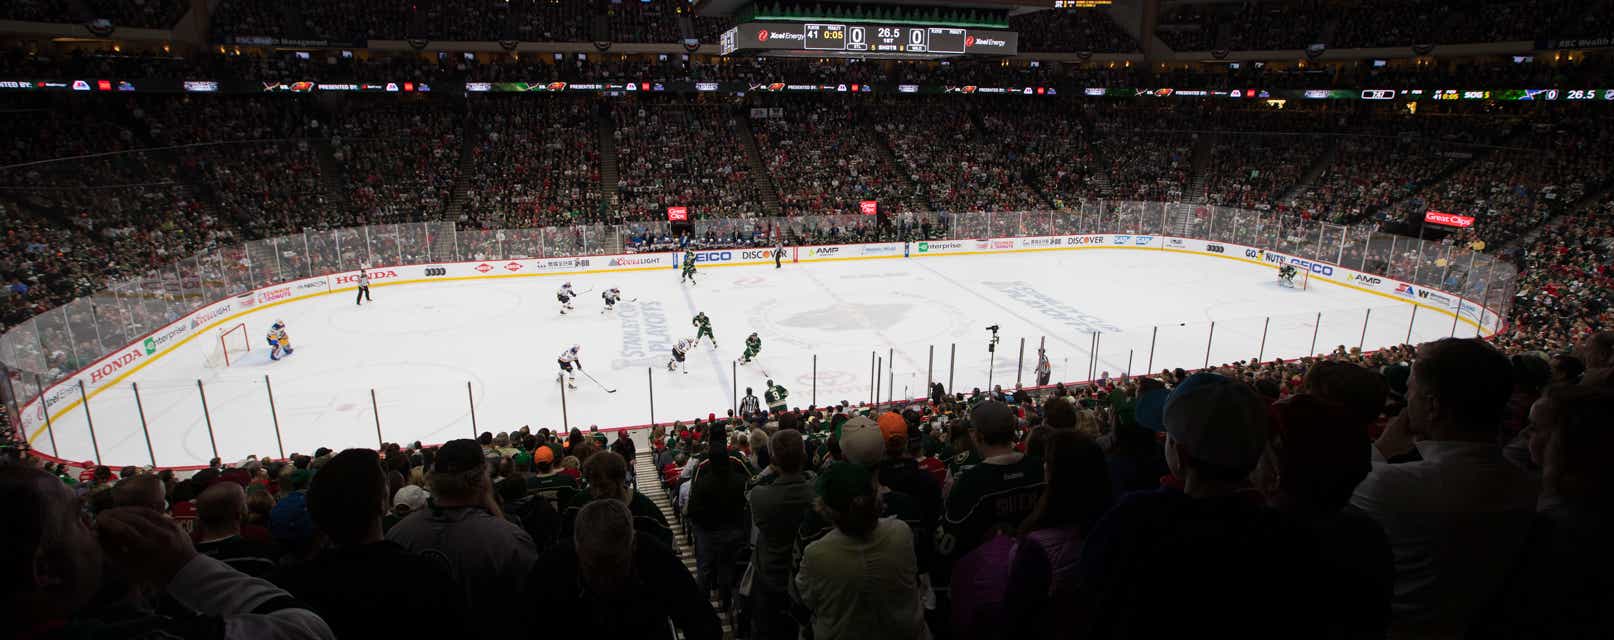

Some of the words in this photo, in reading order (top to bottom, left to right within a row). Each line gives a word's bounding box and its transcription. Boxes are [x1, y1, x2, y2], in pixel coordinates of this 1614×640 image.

[808, 30, 818, 38] 41
[824, 31, 844, 39] 0:05
[852, 29, 862, 42] 0
[878, 28, 900, 37] 26.5
[912, 31, 922, 44] 0
[1464, 91, 1483, 99] SOG
[1548, 90, 1556, 100] 0
[1567, 90, 1596, 100] 26.5
[1426, 213, 1448, 222] Great
[1450, 216, 1471, 226] Clips
[1068, 236, 1104, 246] DISCOVER
[685, 252, 732, 263] EICO
[1356, 274, 1381, 284] AMP
[90, 349, 143, 384] HONDA
